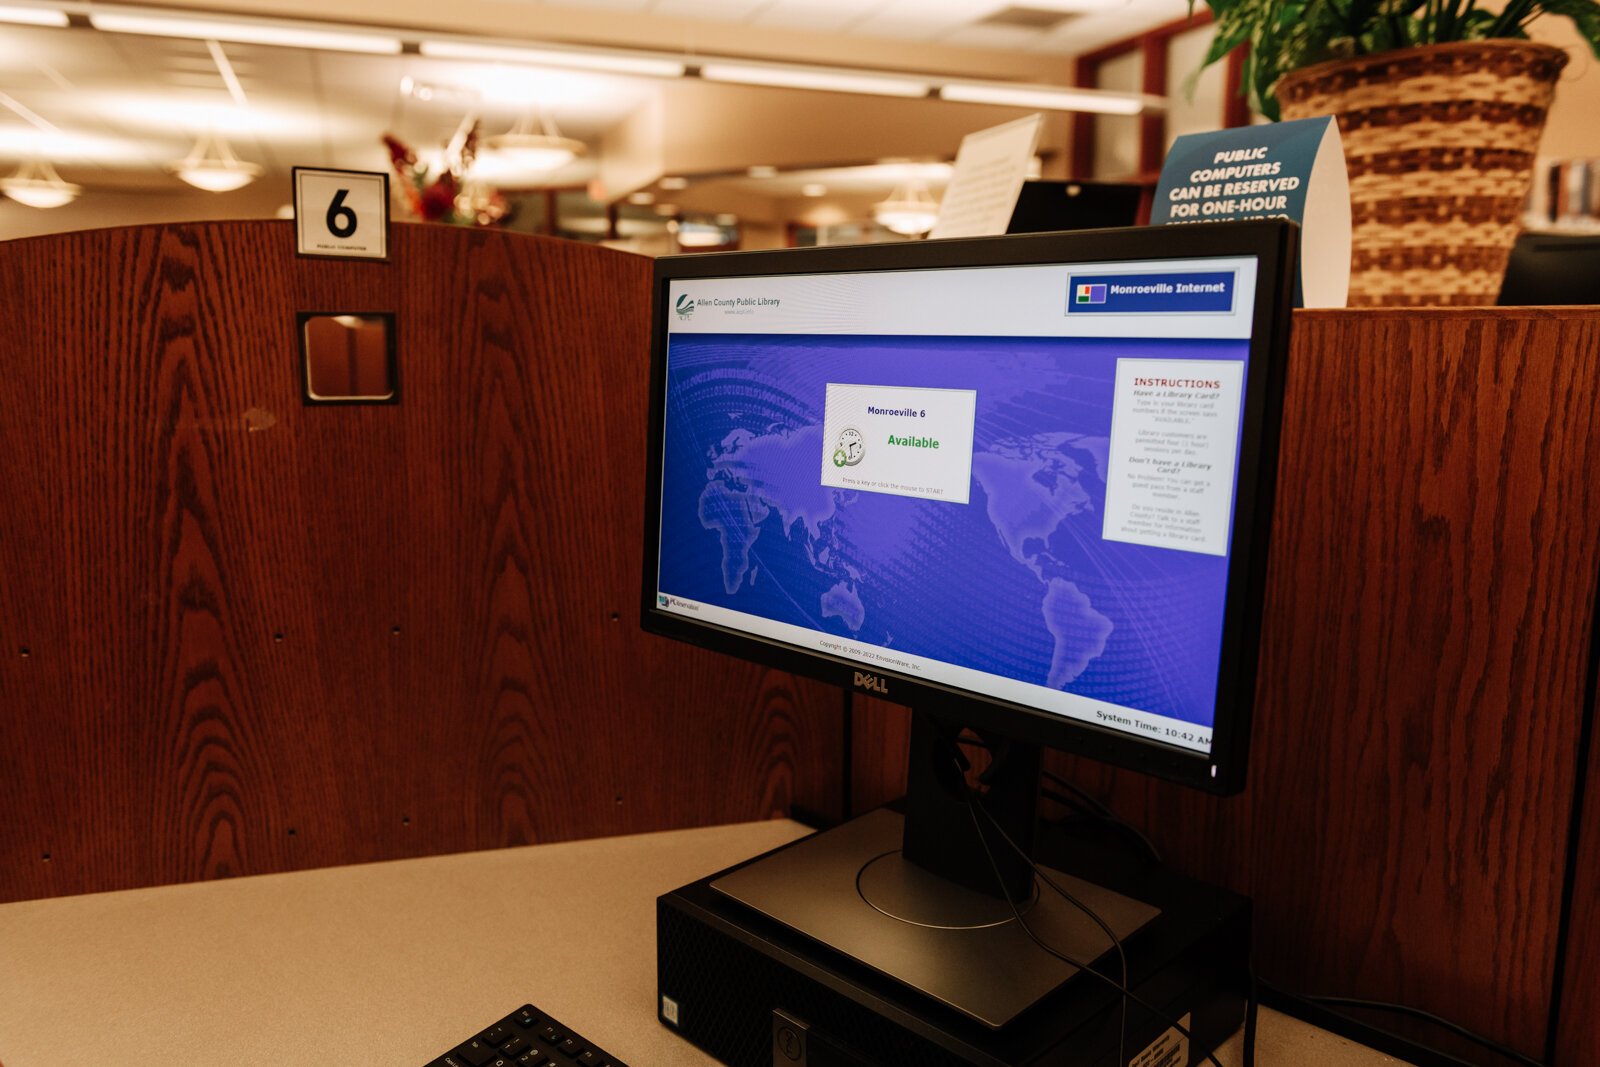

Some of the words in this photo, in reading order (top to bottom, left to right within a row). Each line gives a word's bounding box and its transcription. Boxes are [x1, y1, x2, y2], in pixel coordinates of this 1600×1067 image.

[1213, 147, 1268, 164] PUBLIC
[1190, 162, 1281, 183] COMPUTERS
[1168, 186, 1201, 201] CAN
[1203, 183, 1222, 198] BE
[1223, 176, 1300, 196] RESERVED
[326, 189, 357, 238] 6
[1170, 202, 1199, 218] FOR
[1201, 195, 1287, 215] ONE-HOUR
[1110, 283, 1173, 294] Monroeville
[1175, 282, 1225, 293] Internet
[697, 298, 712, 306] Allen
[713, 298, 735, 308] County
[736, 297, 756, 306] Public
[757, 297, 780, 307] Library
[1134, 377, 1220, 389] INSTRUCTIONS
[1163, 390, 1192, 399] Library
[867, 406, 917, 418] Monroeville
[919, 409, 926, 418] 6
[887, 434, 940, 449] Available
[1128, 456, 1150, 465] Don't
[1152, 458, 1172, 467] have
[1181, 460, 1213, 471] Library
[842, 476, 855, 485] Press
[861, 479, 870, 487] key
[877, 481, 889, 489] click
[890, 482, 899, 490] the
[899, 484, 918, 492] mouse
[926, 487, 944, 495] START
[819, 640, 842, 651] Copyright
[848, 647, 875, 659] 2009-2022
[876, 654, 911, 669] EnvisionWare,
[911, 663, 922, 671] Inc.
[853, 671, 889, 694] DELL
[1096, 710, 1132, 726] System
[1135, 719, 1161, 734] Time:
[1165, 727, 1194, 741] 10:42
